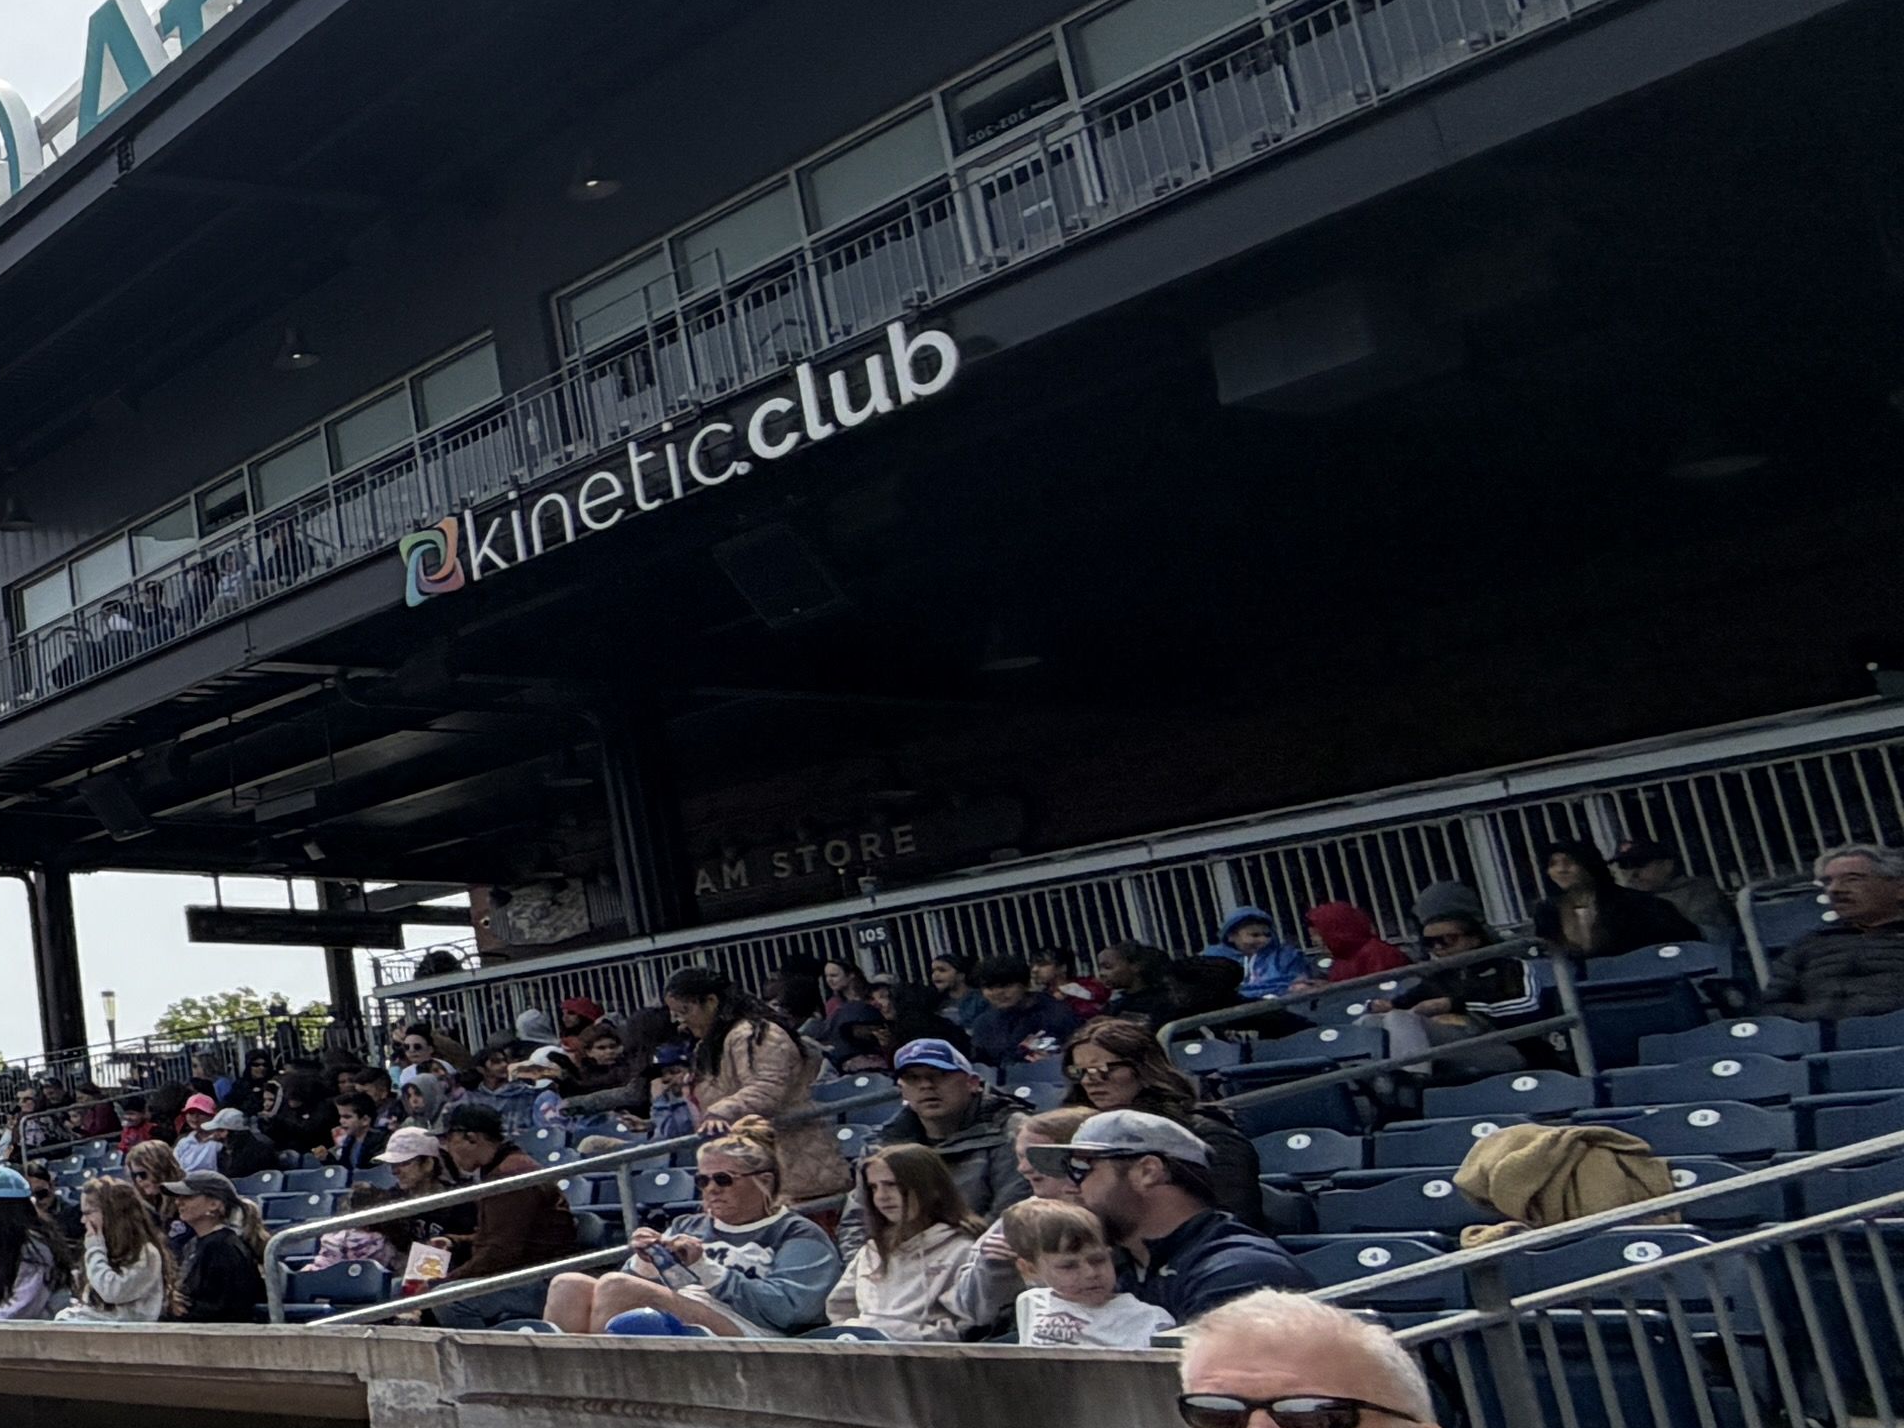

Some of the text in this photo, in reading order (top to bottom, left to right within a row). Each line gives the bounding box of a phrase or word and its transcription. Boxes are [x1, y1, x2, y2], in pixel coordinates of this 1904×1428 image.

[747, 320, 961, 460] club
[771, 823, 917, 879] STORE
[858, 926, 887, 945] 105
